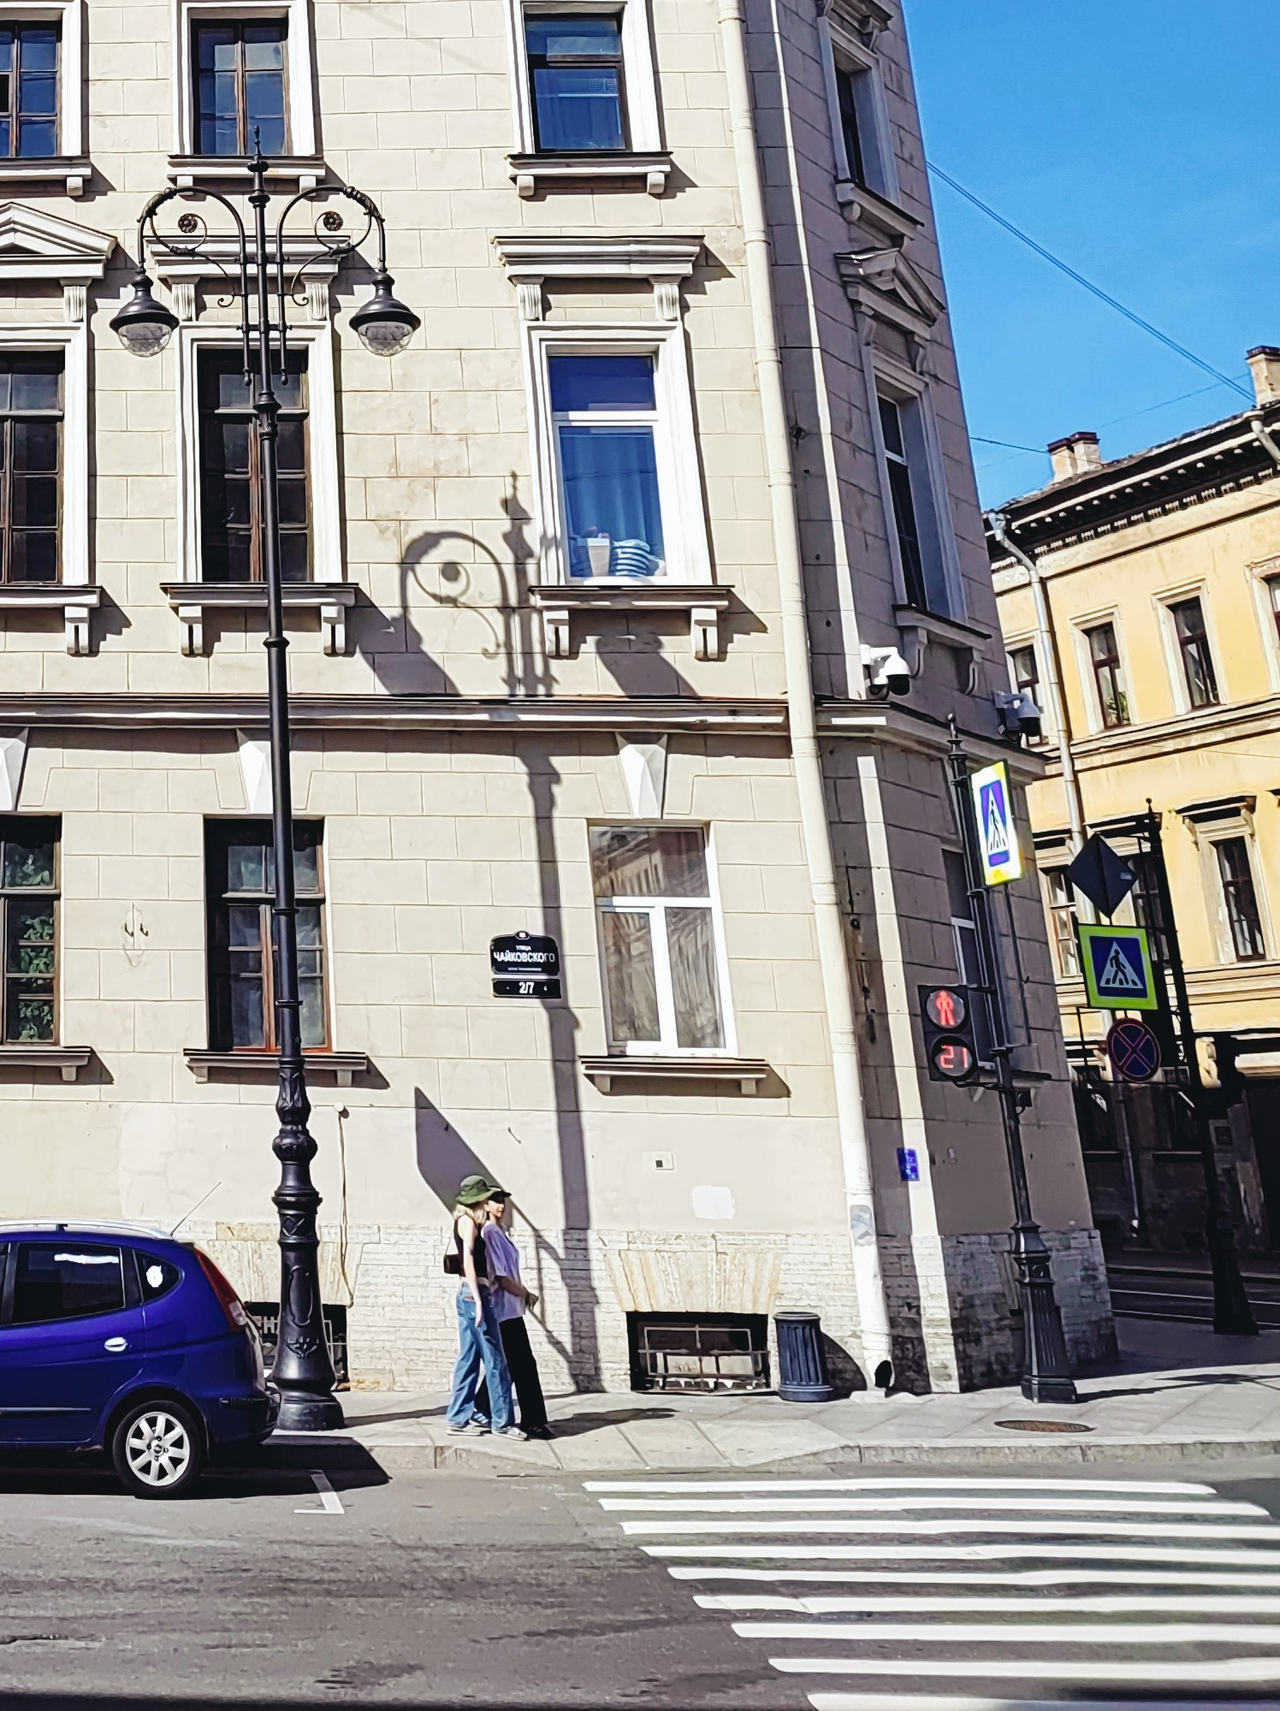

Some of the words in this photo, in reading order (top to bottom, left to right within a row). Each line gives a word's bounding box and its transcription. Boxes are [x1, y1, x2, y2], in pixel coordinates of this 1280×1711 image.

[493, 950, 556, 963] ЧАЙКОВСКОГО
[519, 982, 535, 994] 2/7
[940, 1044, 969, 1068] 21
